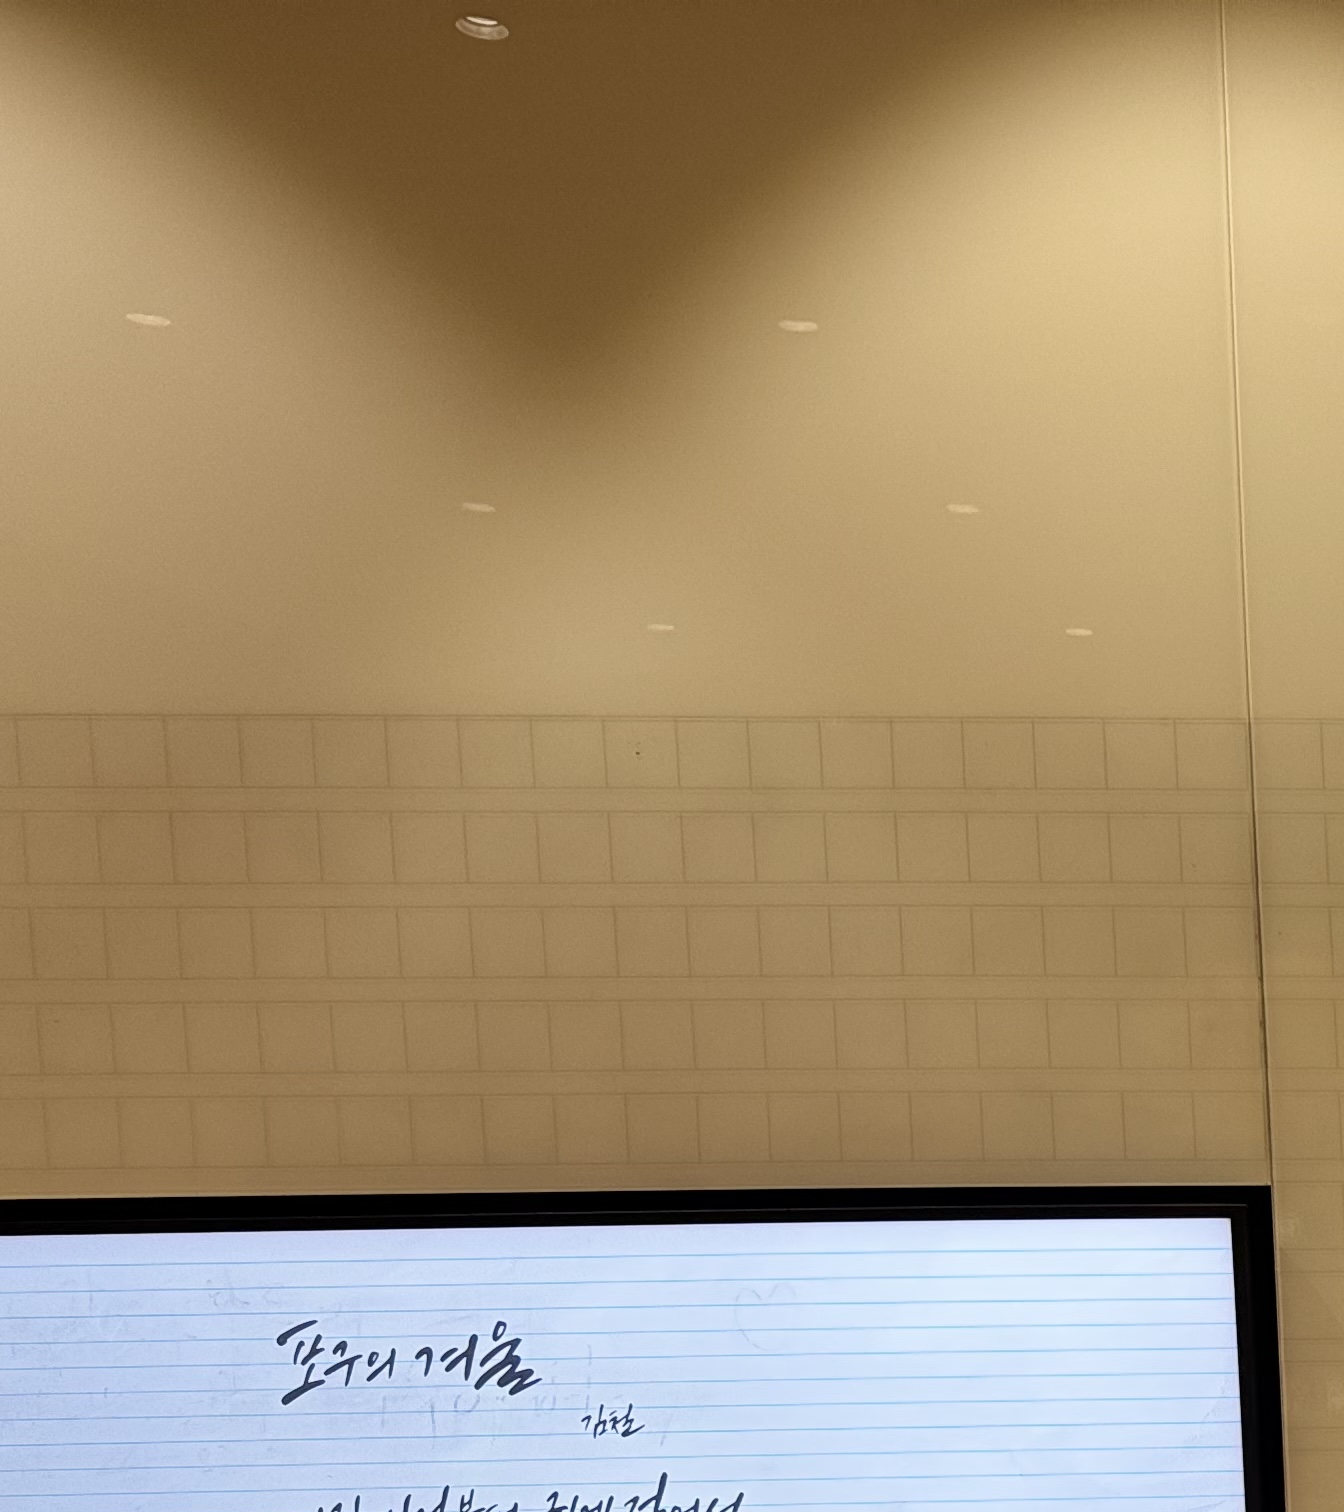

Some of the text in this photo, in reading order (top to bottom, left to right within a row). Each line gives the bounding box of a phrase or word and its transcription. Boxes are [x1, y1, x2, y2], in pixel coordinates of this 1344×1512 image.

[276, 1319, 542, 1406] 포구의 겨울
[581, 1403, 645, 1438] 김철
